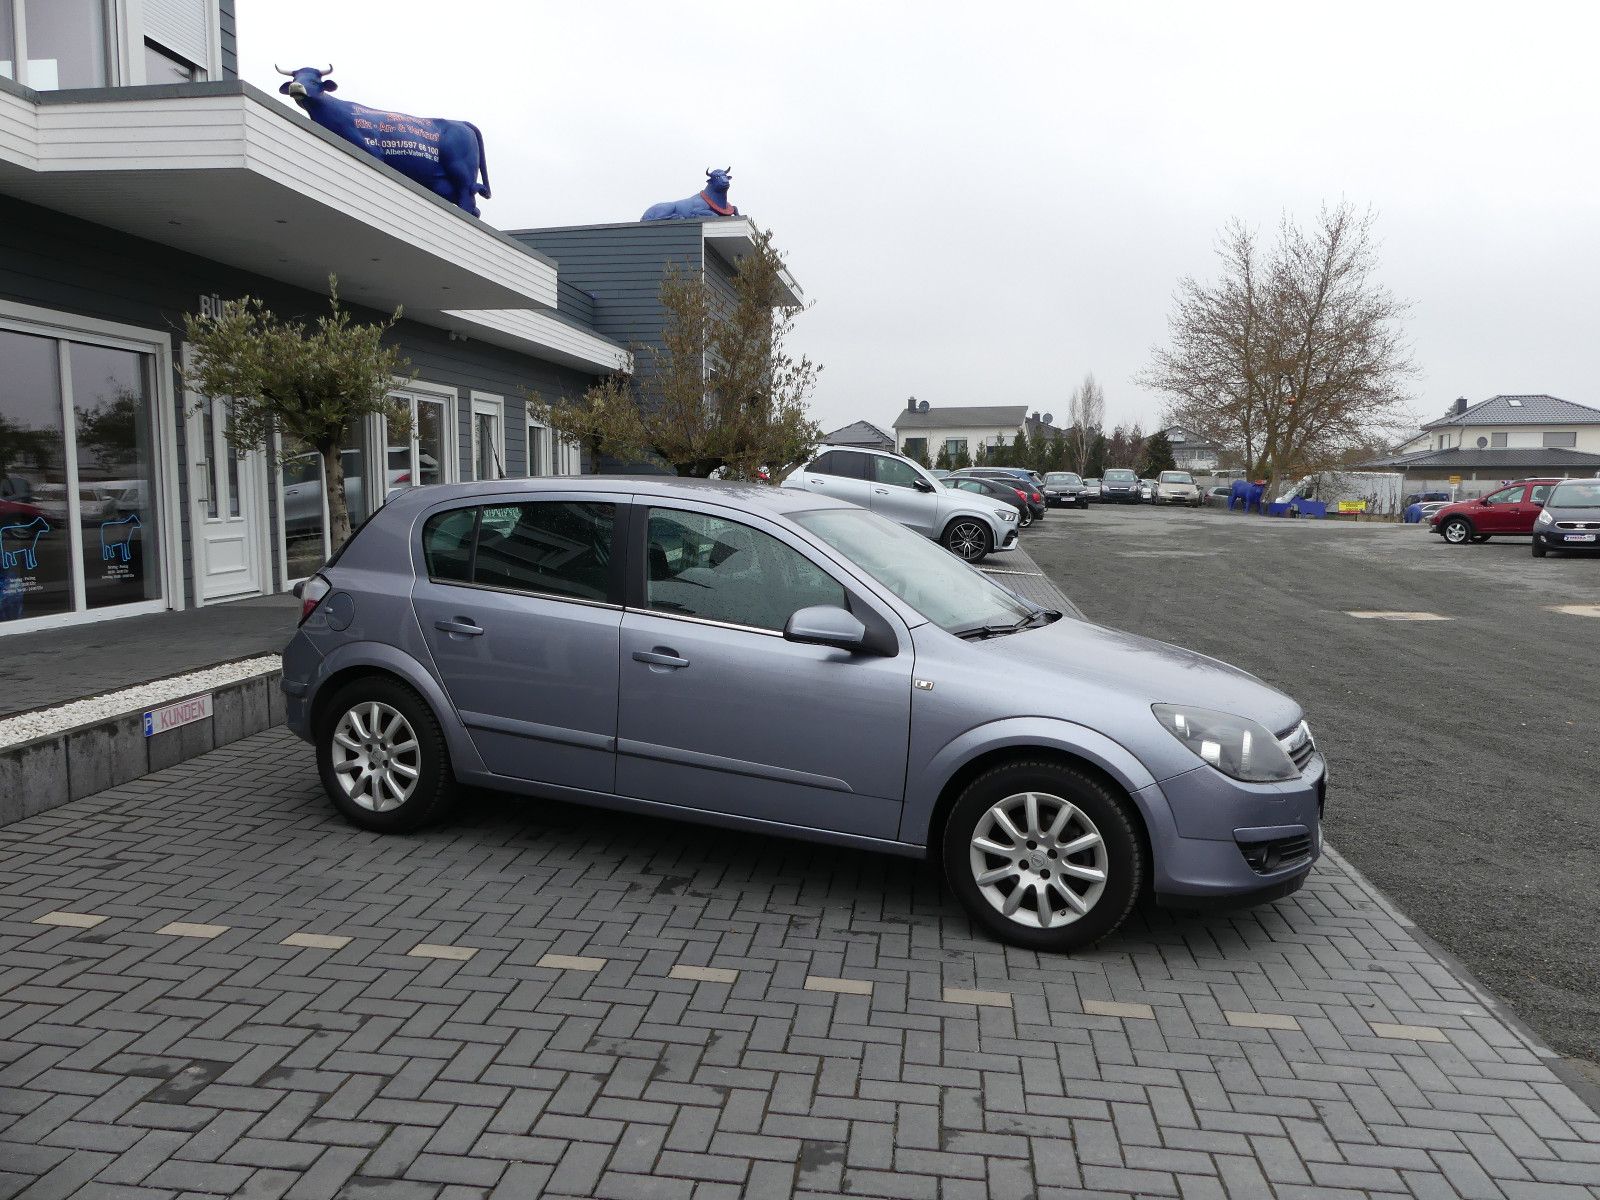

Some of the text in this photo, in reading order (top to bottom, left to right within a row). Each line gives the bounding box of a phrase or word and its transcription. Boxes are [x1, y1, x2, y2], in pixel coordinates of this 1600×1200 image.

[364, 137, 380, 146] Tel.
[381, 140, 417, 149] 0391/597
[428, 146, 439, 155] 100
[145, 699, 206, 732] P KUNDEN
